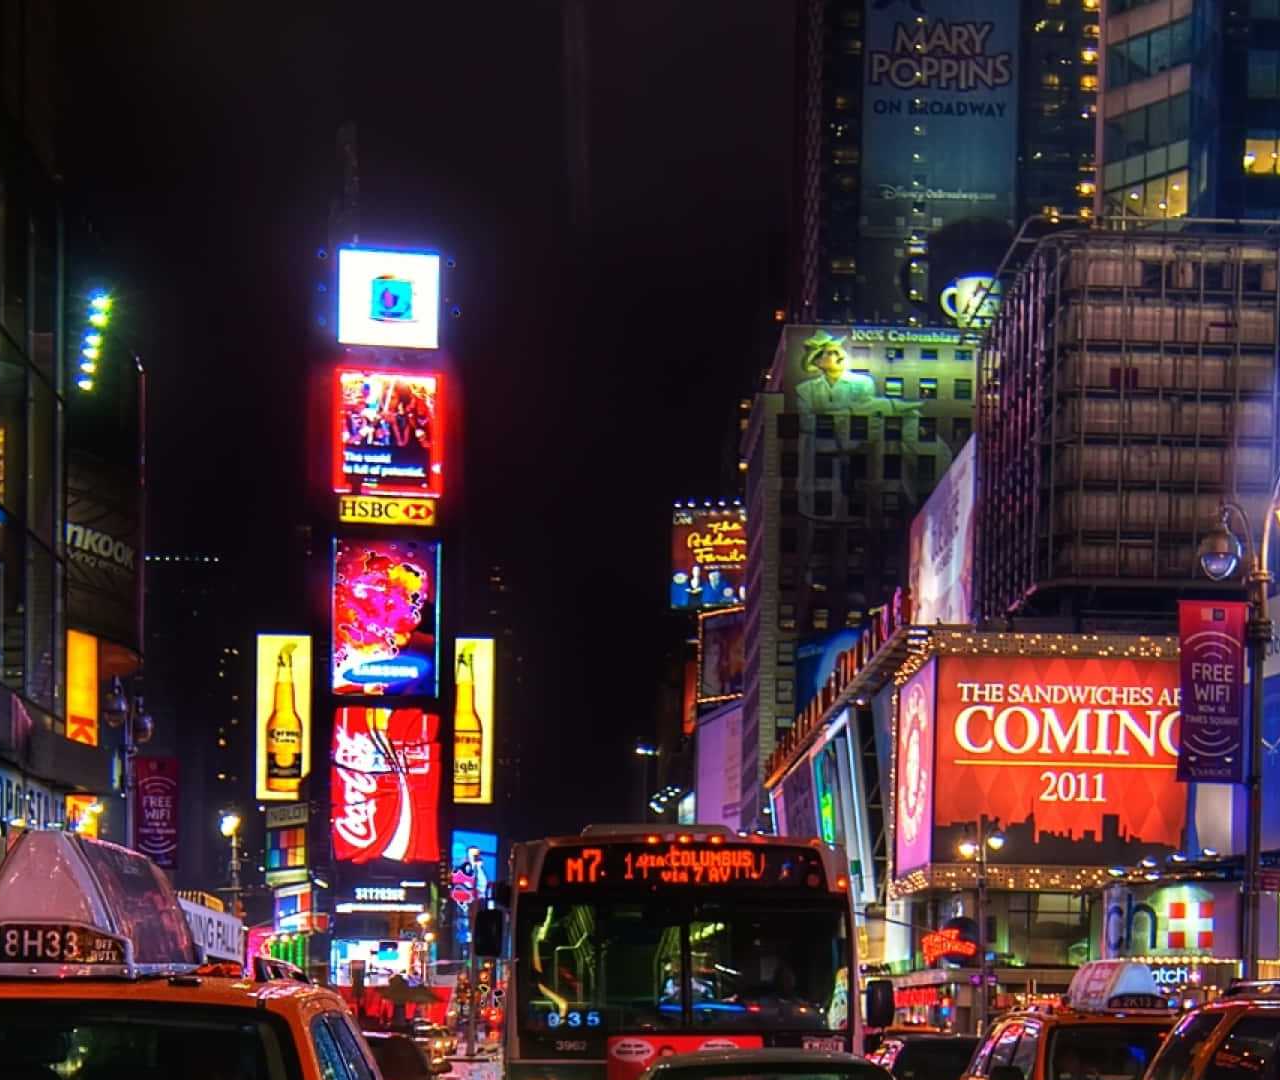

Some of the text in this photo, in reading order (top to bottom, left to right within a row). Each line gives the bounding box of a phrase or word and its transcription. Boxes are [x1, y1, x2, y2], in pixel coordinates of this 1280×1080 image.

[895, 22, 991, 55] MARY
[871, 53, 1011, 90] POPPINS
[874, 99, 901, 115] ON
[908, 100, 1006, 118] BROADWAY
[341, 500, 400, 519] HSBC
[1190, 662, 1235, 683] FREE
[957, 682, 1004, 704] THE
[1007, 683, 1154, 707] SANDWICHES
[1193, 684, 1231, 702] WIFI
[1039, 770, 1107, 803] 2011
[669, 850, 753, 867] COLUMBUS
[660, 867, 732, 883] via 7 AV
[3, 928, 79, 959] 8H33
[94, 938, 114, 950] OFF
